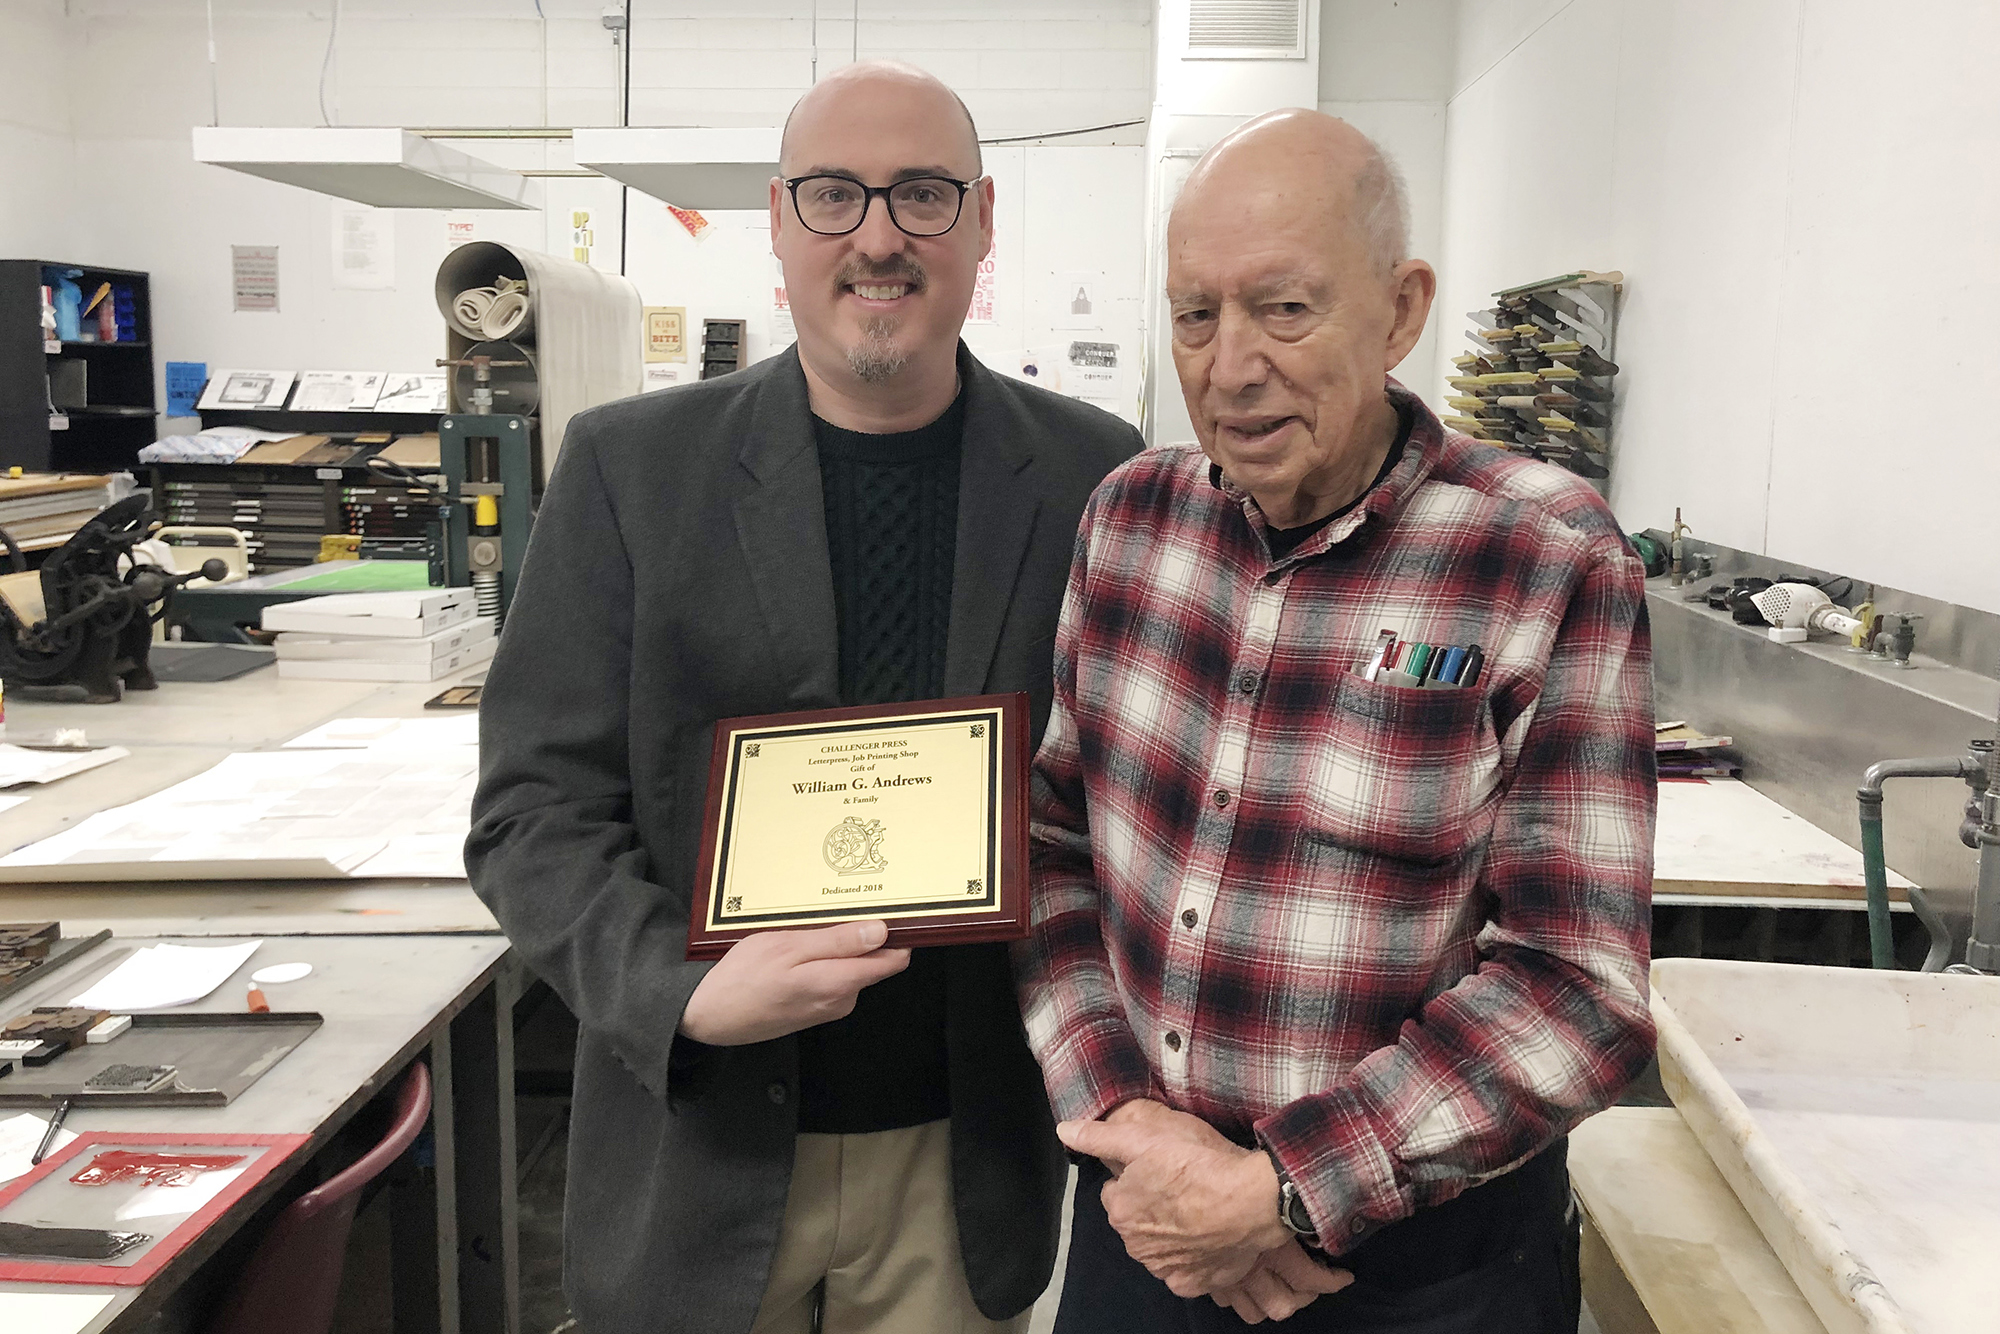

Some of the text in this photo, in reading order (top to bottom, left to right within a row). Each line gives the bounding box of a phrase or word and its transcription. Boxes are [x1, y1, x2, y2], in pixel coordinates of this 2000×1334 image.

[654, 320, 676, 328] KISS
[652, 335, 679, 343] BITE
[820, 739, 908, 753] CHALLENGER PRESS
[808, 750, 919, 766] Letterpress, Job Printing Shop
[850, 765, 865, 773] Gift
[792, 774, 933, 795] William G. Andrews
[853, 795, 879, 804] Family
[821, 883, 884, 895] Dedicated 2018
